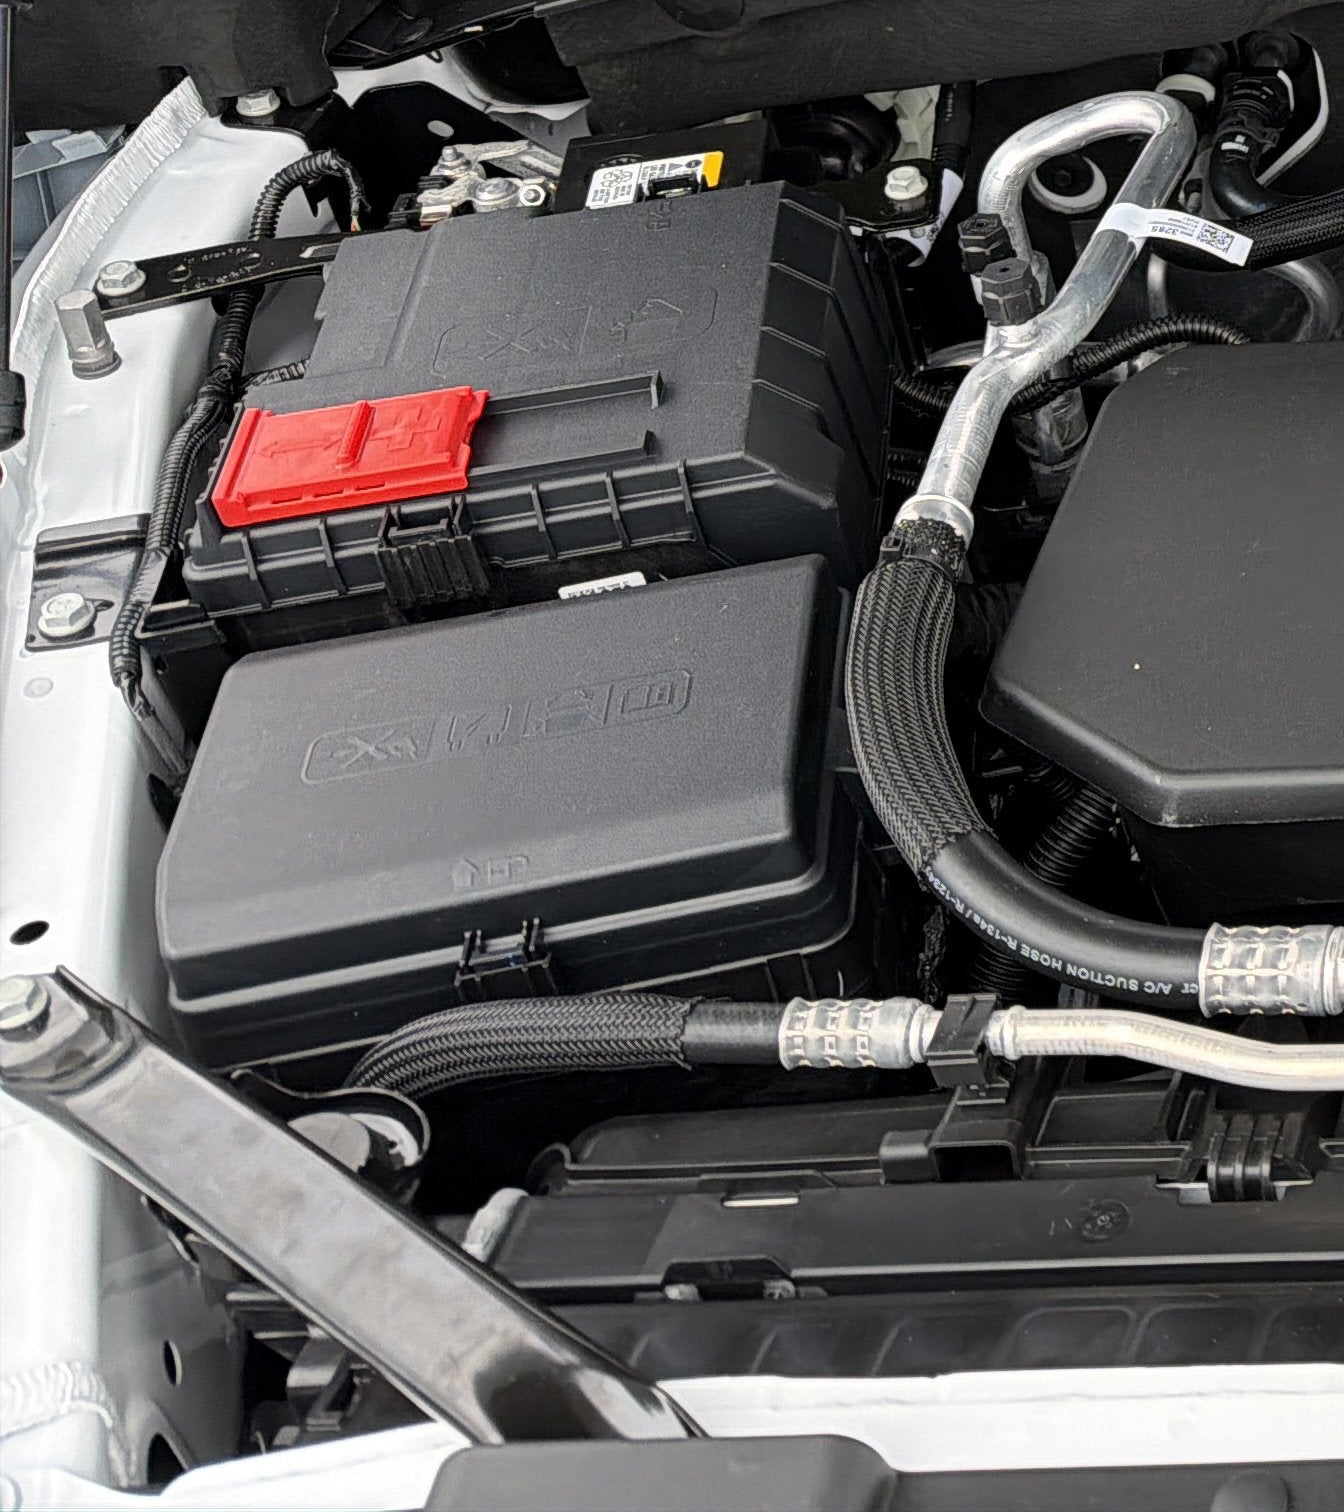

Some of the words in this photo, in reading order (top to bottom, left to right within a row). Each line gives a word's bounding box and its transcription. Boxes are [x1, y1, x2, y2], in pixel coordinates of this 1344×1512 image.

[973, 913, 1018, 951] R-134a
[1020, 943, 1063, 971] HOSE
[1066, 963, 1139, 992] SUCTION
[1143, 981, 1172, 994] A/C
